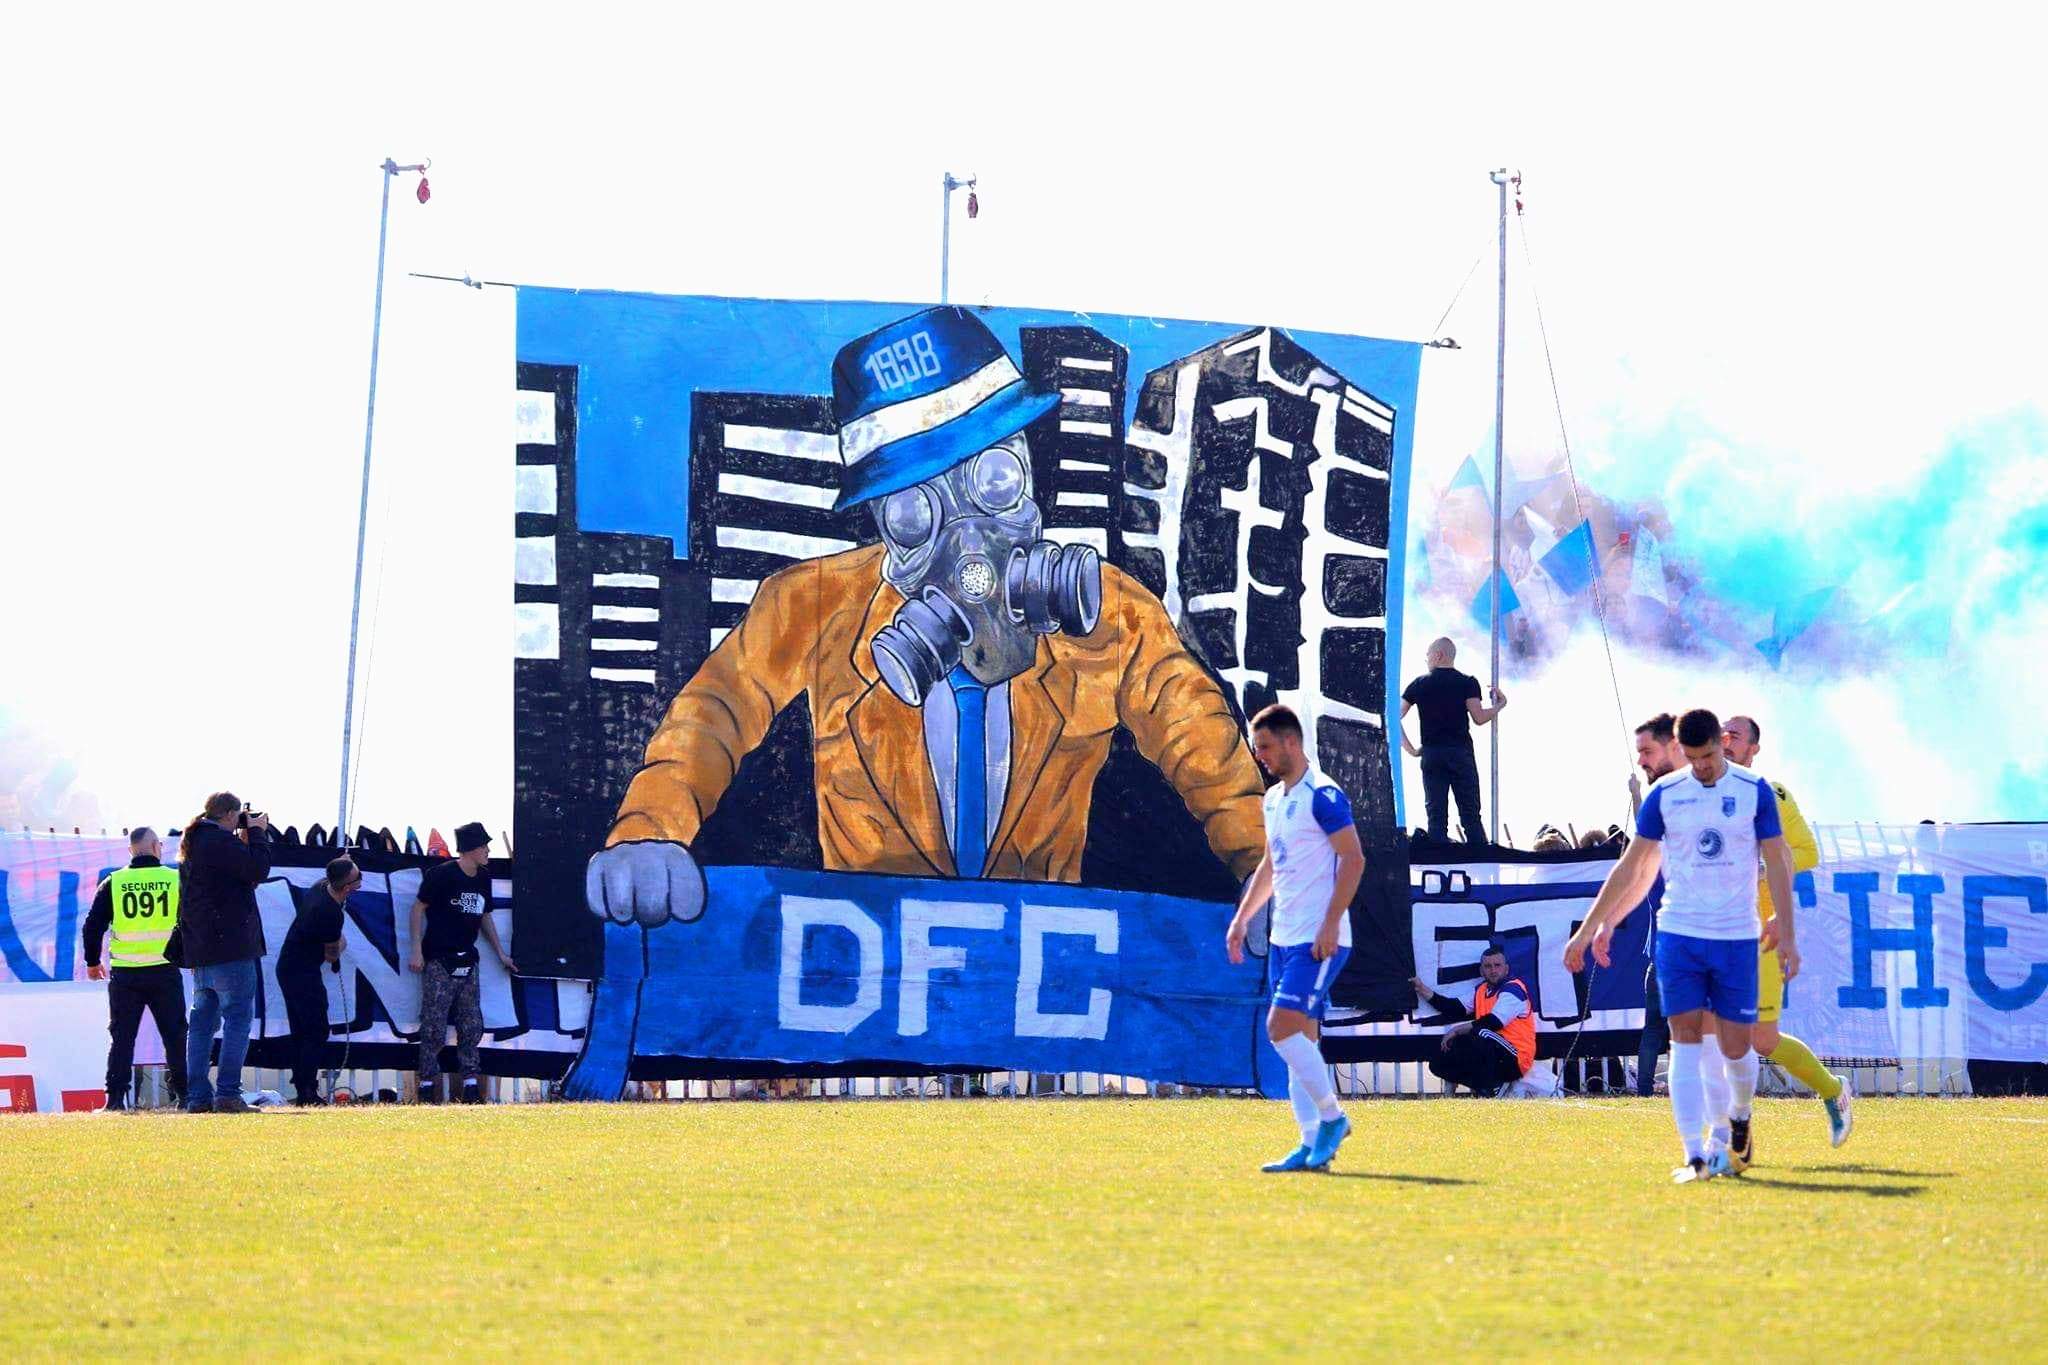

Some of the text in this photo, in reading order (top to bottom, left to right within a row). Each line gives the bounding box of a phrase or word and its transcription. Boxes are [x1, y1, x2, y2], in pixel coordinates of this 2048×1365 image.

[864, 331, 942, 392] 1998
[121, 881, 172, 892] SECURITY
[122, 891, 169, 919] 091
[778, 895, 1119, 1040] DFC
